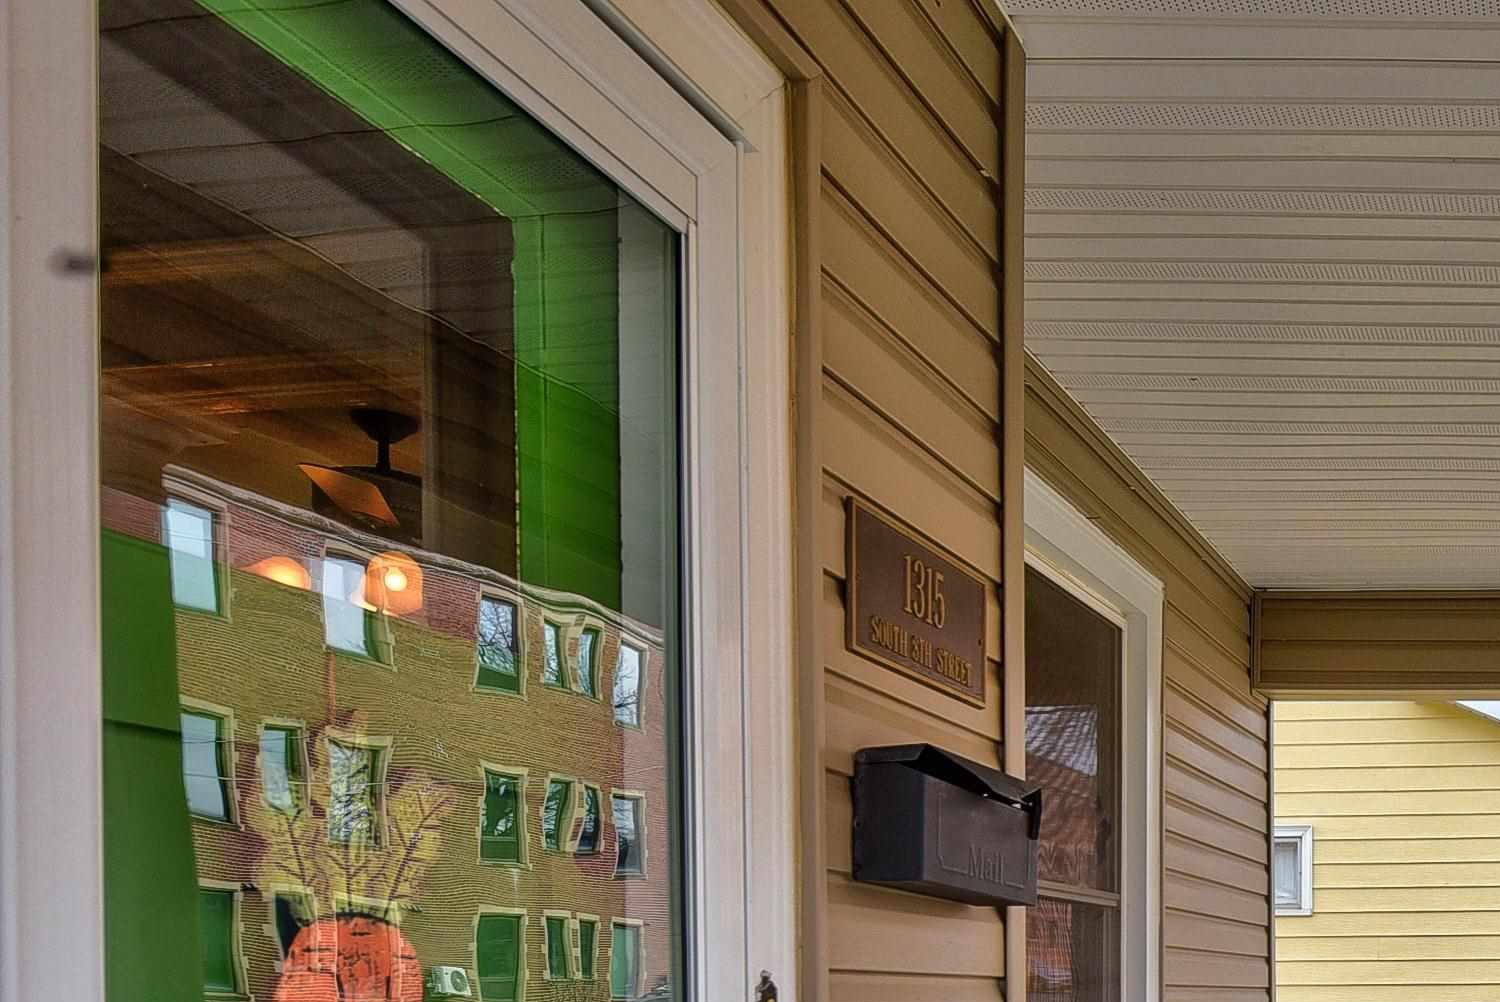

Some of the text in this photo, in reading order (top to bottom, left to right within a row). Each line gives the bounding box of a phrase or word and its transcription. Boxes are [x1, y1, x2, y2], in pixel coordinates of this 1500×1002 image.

[902, 555, 945, 629] 1315
[871, 615, 908, 657] SOUTH
[936, 648, 972, 689] STREET
[968, 843, 1004, 886] Mail
